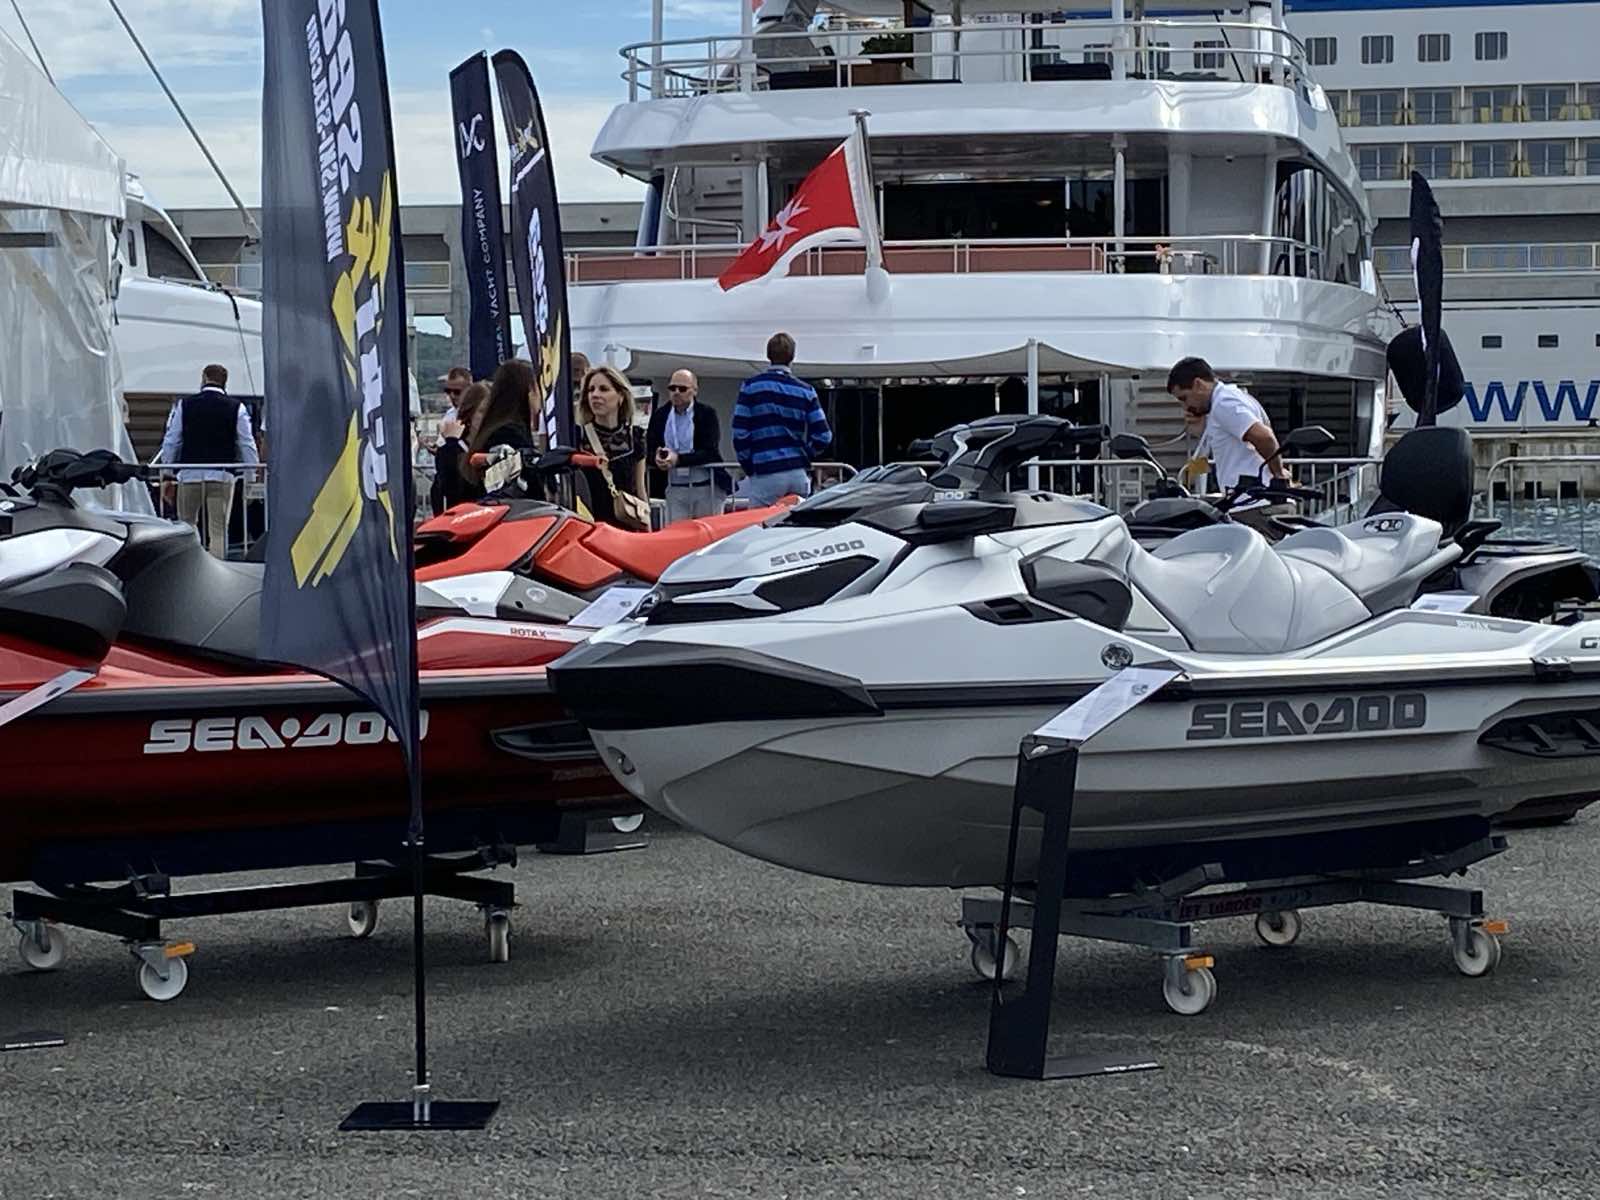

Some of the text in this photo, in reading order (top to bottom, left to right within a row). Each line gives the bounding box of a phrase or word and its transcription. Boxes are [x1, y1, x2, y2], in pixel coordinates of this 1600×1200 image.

[472, 188, 491, 264] COMPANY
[485, 268, 500, 319] YACHT
[510, 627, 547, 639] ROTAX
